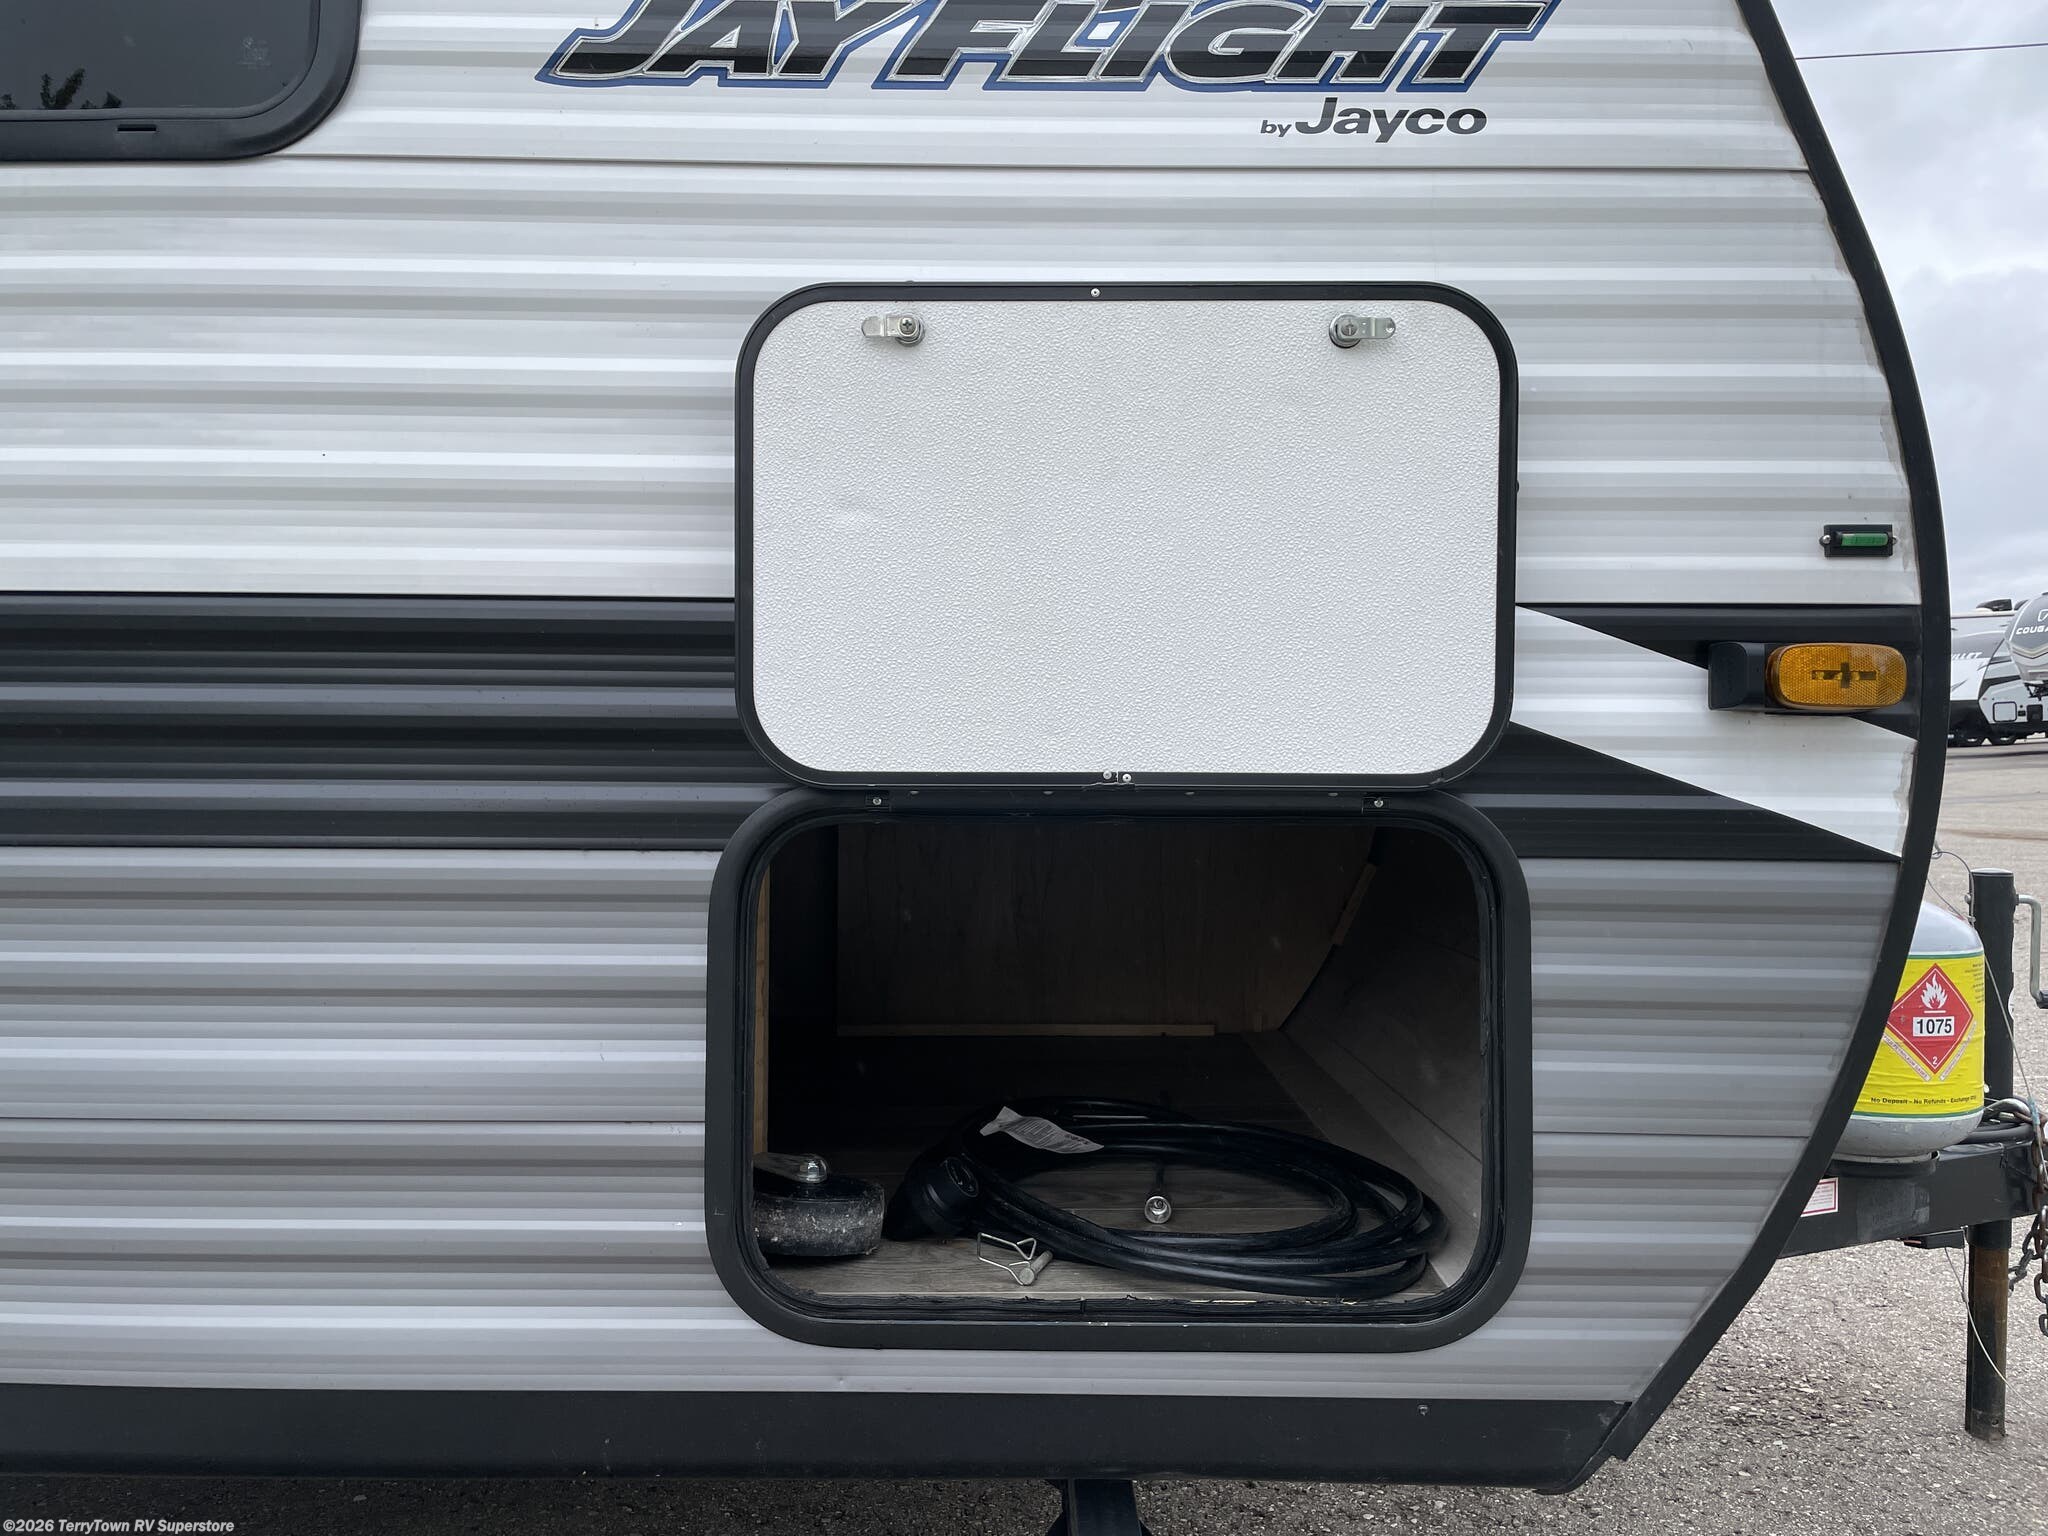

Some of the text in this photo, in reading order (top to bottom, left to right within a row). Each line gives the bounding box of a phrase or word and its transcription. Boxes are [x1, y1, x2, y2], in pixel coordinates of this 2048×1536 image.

[535, 0, 1556, 92] JAY FLIGHT
[1260, 97, 1488, 143] by Jayco
[1916, 1018, 1952, 1034] 1075
[1932, 1056, 1938, 1065] 2
[1882, 1097, 1908, 1105] Deposit
